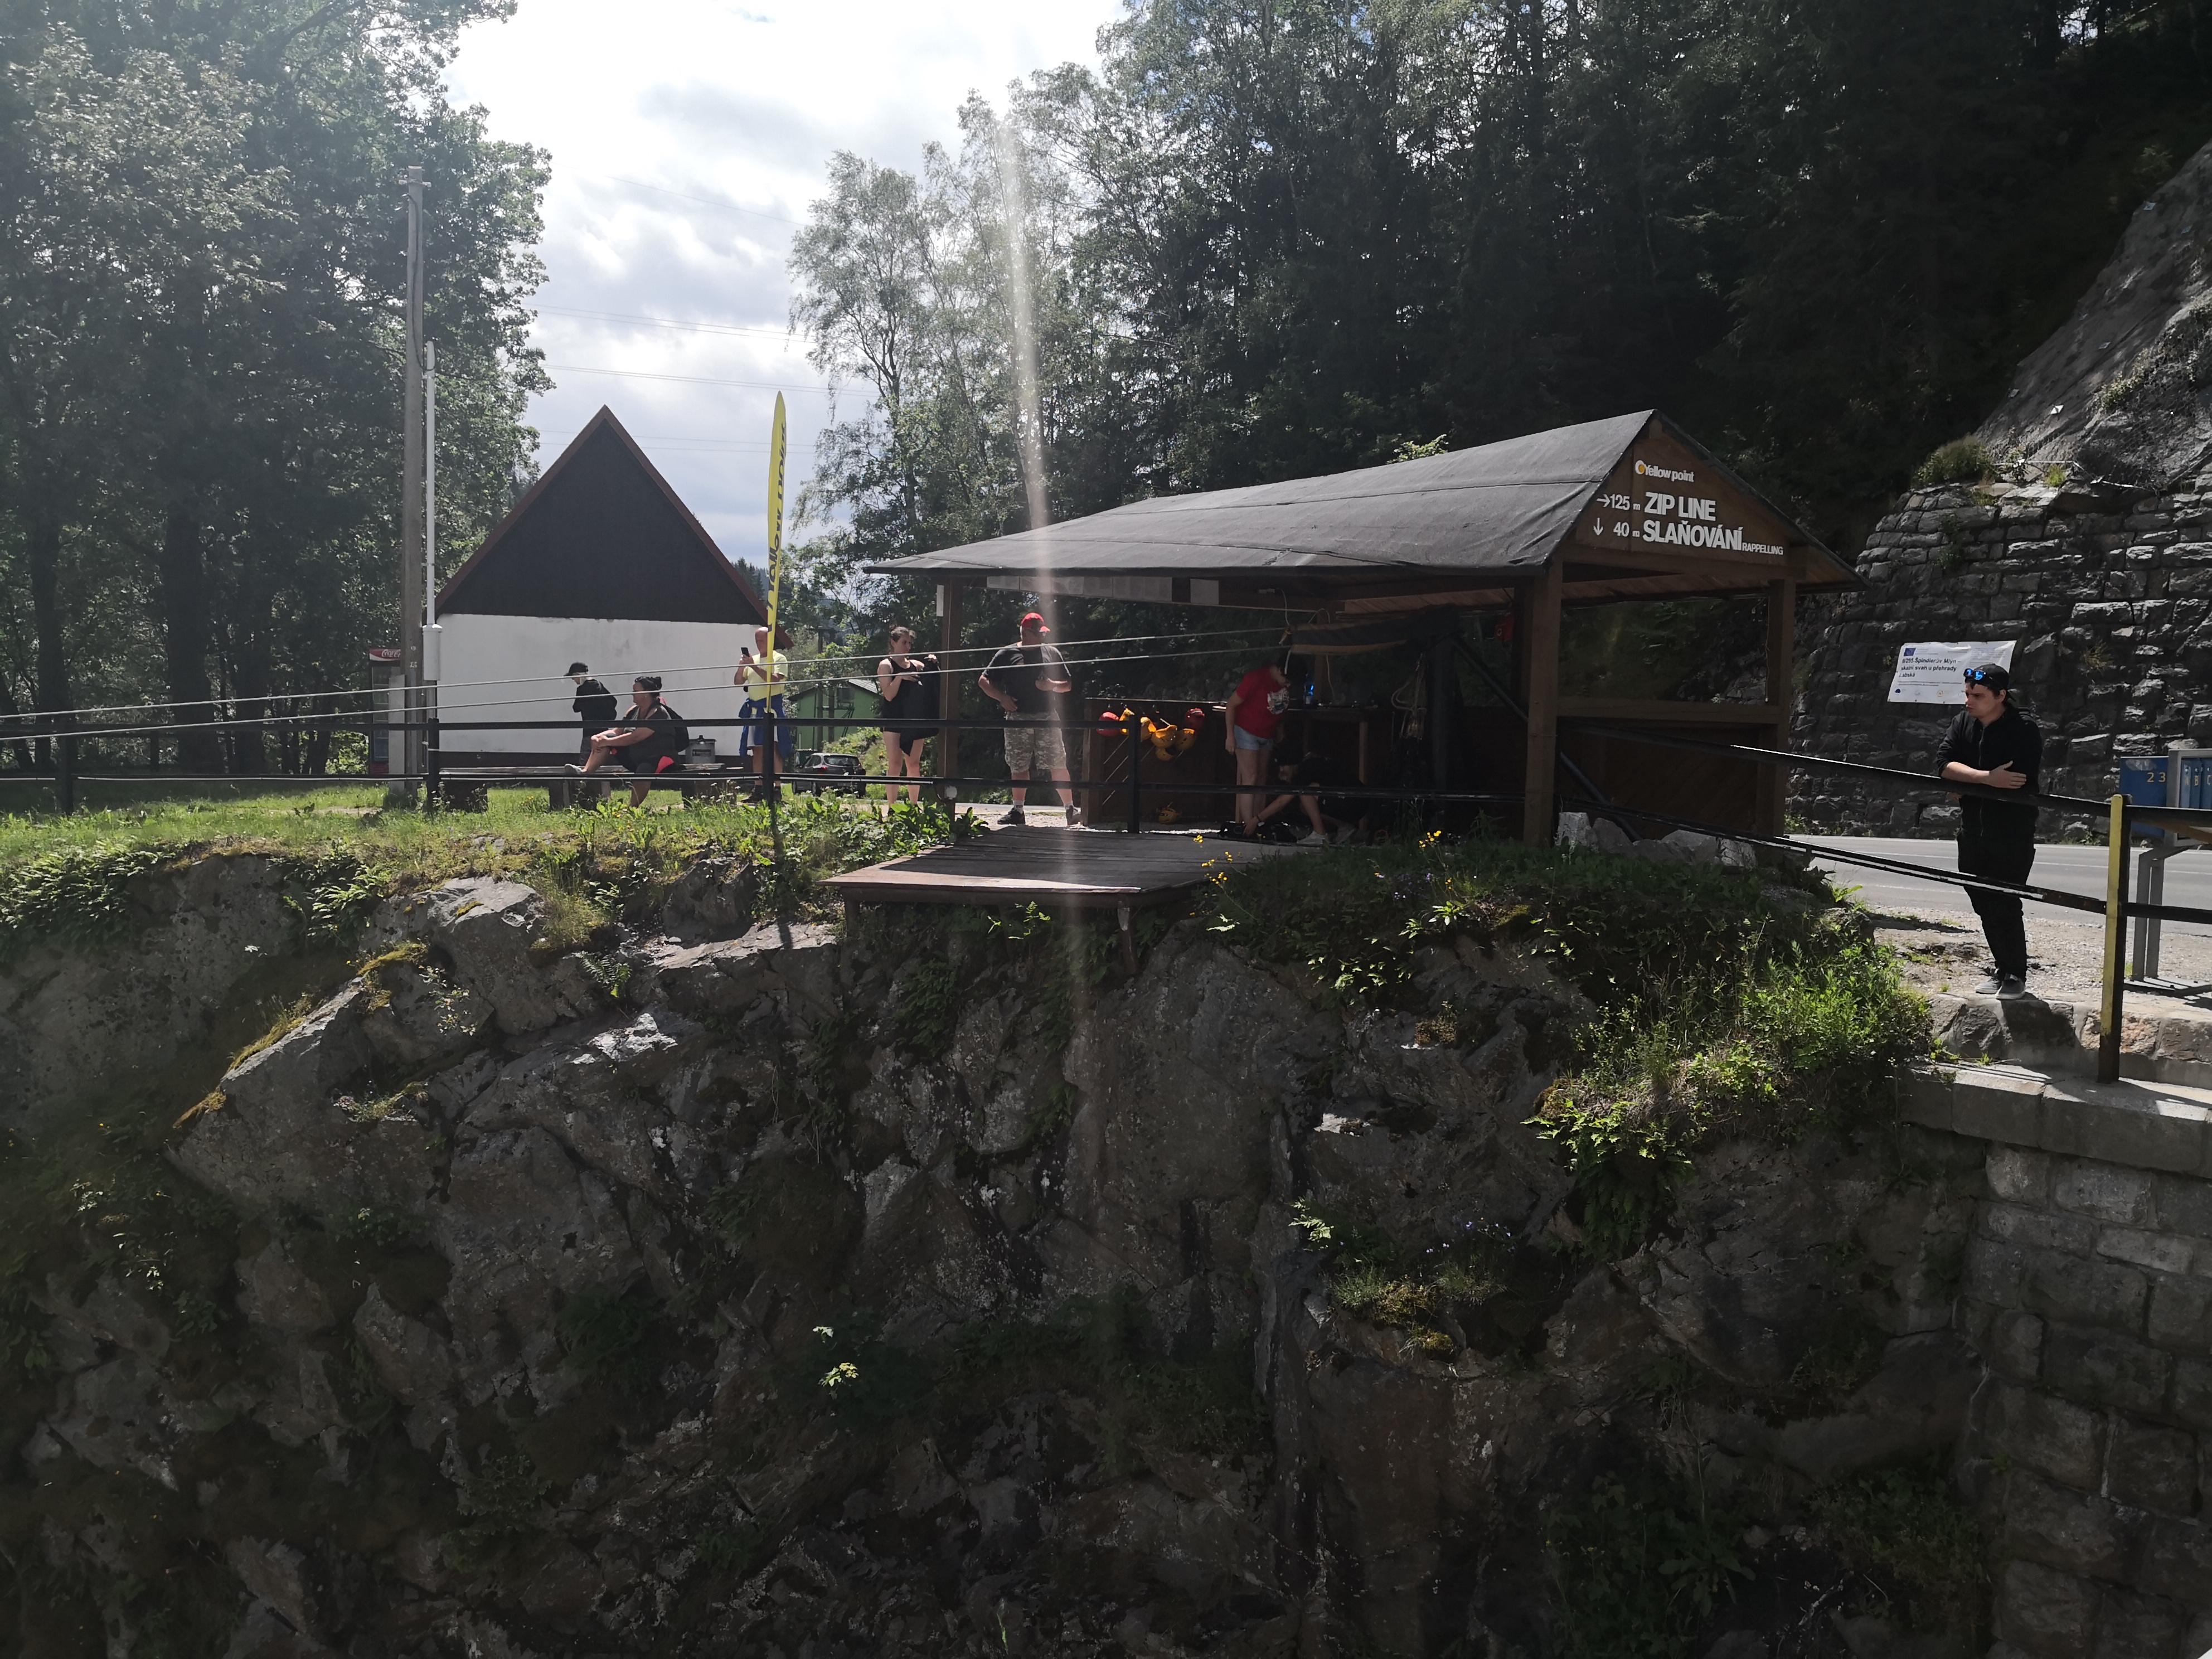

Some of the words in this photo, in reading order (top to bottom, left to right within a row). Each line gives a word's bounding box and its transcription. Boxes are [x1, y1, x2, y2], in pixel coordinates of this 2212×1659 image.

[1645, 465, 1671, 478] Yellow
[1672, 470, 1694, 482] point
[1611, 494, 1630, 511] 125
[1645, 492, 1675, 515] ZIP
[1679, 496, 1716, 521] LINE
[1613, 522, 1629, 537] 40
[1643, 520, 1743, 551] SLAŇOVÁNÍ
[1743, 542, 1783, 555] RAPPELLING
